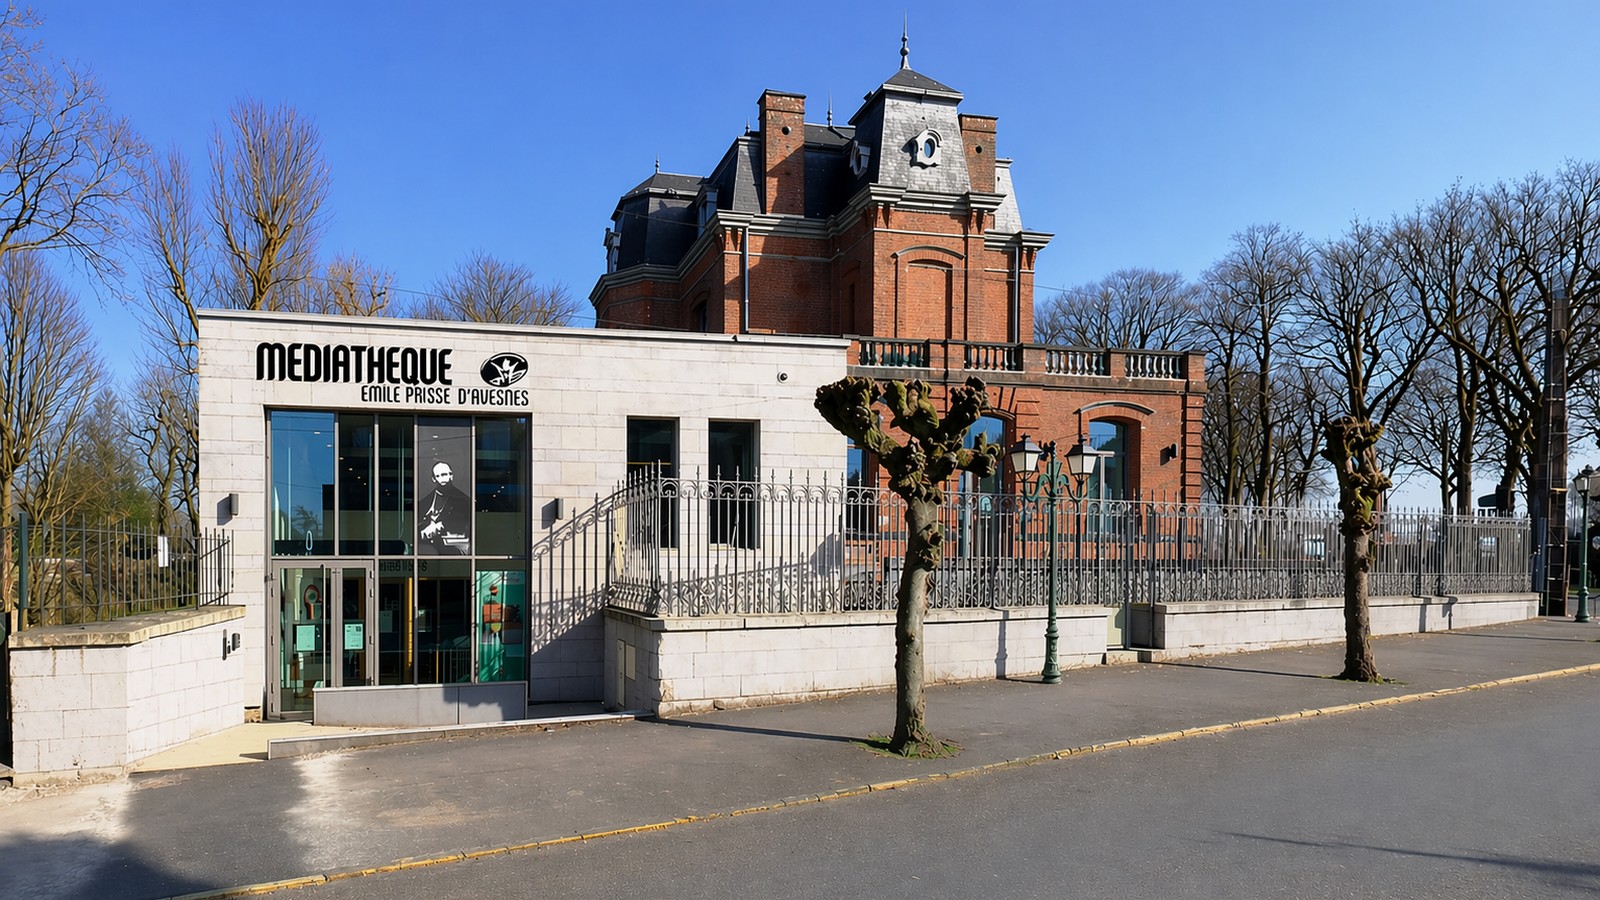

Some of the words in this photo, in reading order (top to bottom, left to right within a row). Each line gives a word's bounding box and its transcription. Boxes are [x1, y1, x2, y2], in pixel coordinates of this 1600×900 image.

[256, 342, 453, 386] MEDIATHEQUE
[361, 385, 401, 403] EMILE
[405, 386, 451, 405] PRISSE
[458, 388, 529, 407] D'AVESNES
